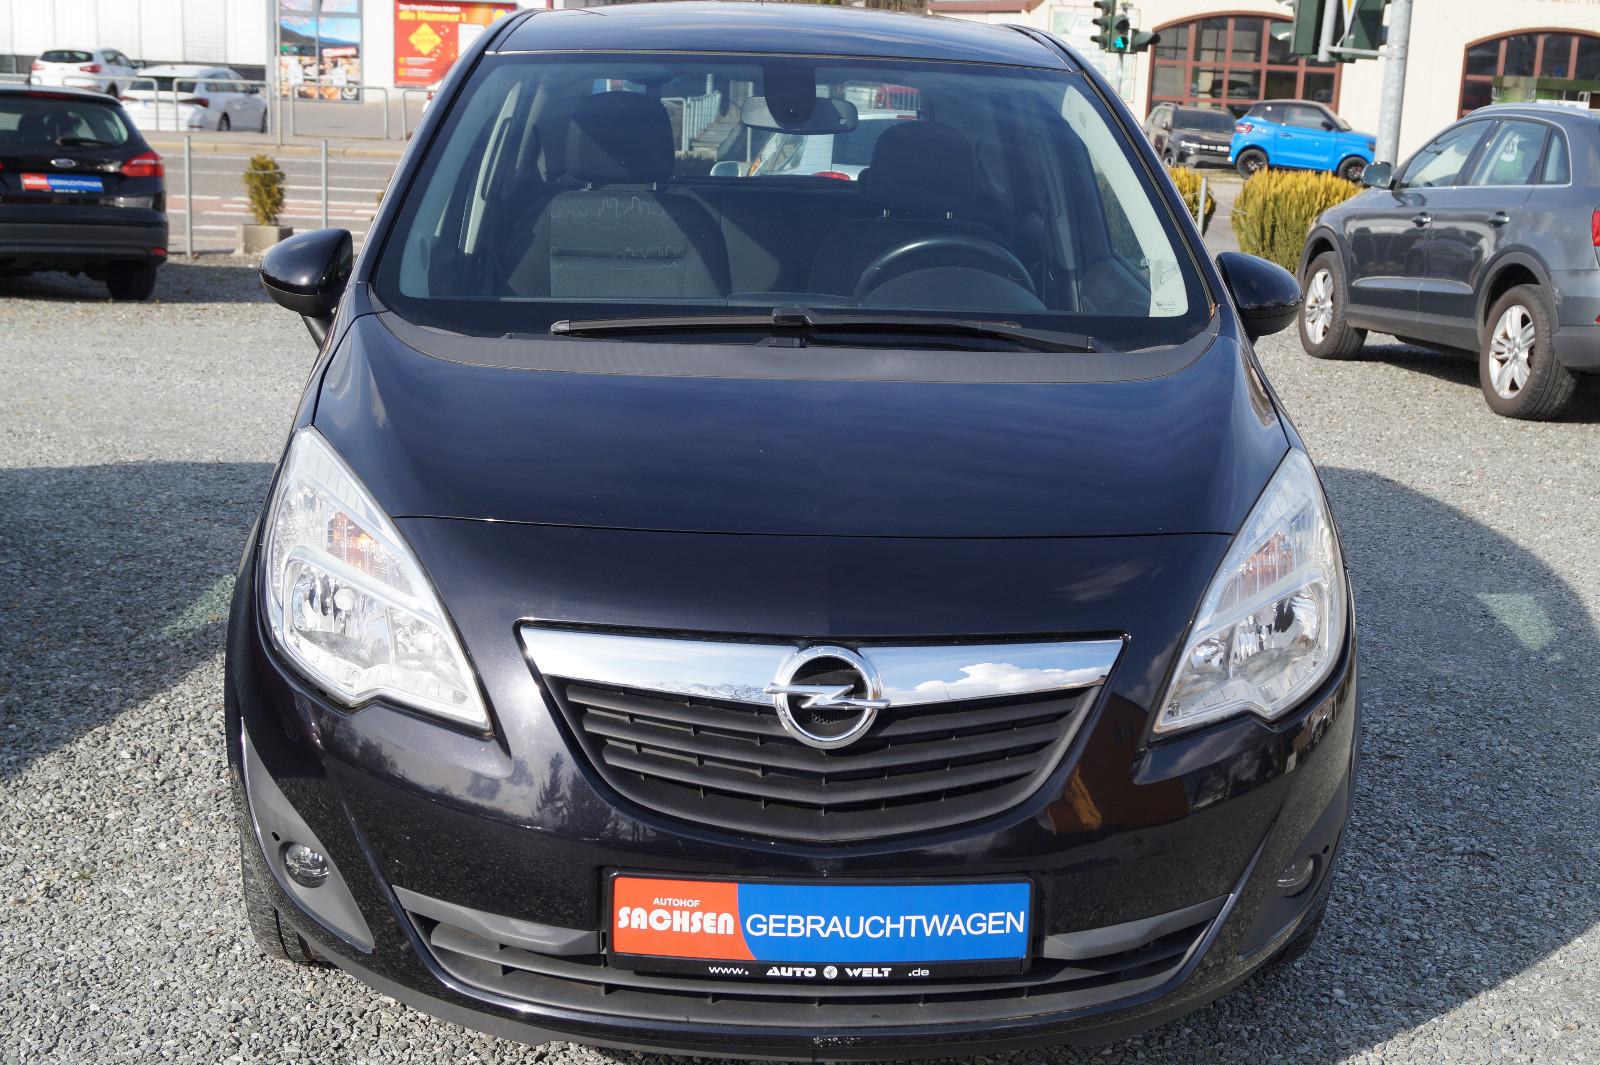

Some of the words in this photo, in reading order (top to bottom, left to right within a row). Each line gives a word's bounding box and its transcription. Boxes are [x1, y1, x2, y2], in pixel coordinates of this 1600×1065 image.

[653, 897, 701, 908] AUTOHOF
[618, 906, 735, 935] SACHSEN
[745, 911, 1025, 939] GEBRAUCHTWAGEN
[708, 966, 749, 976] www.
[766, 966, 817, 977] AUTO
[844, 967, 892, 978] WELT
[908, 968, 930, 977] .de
